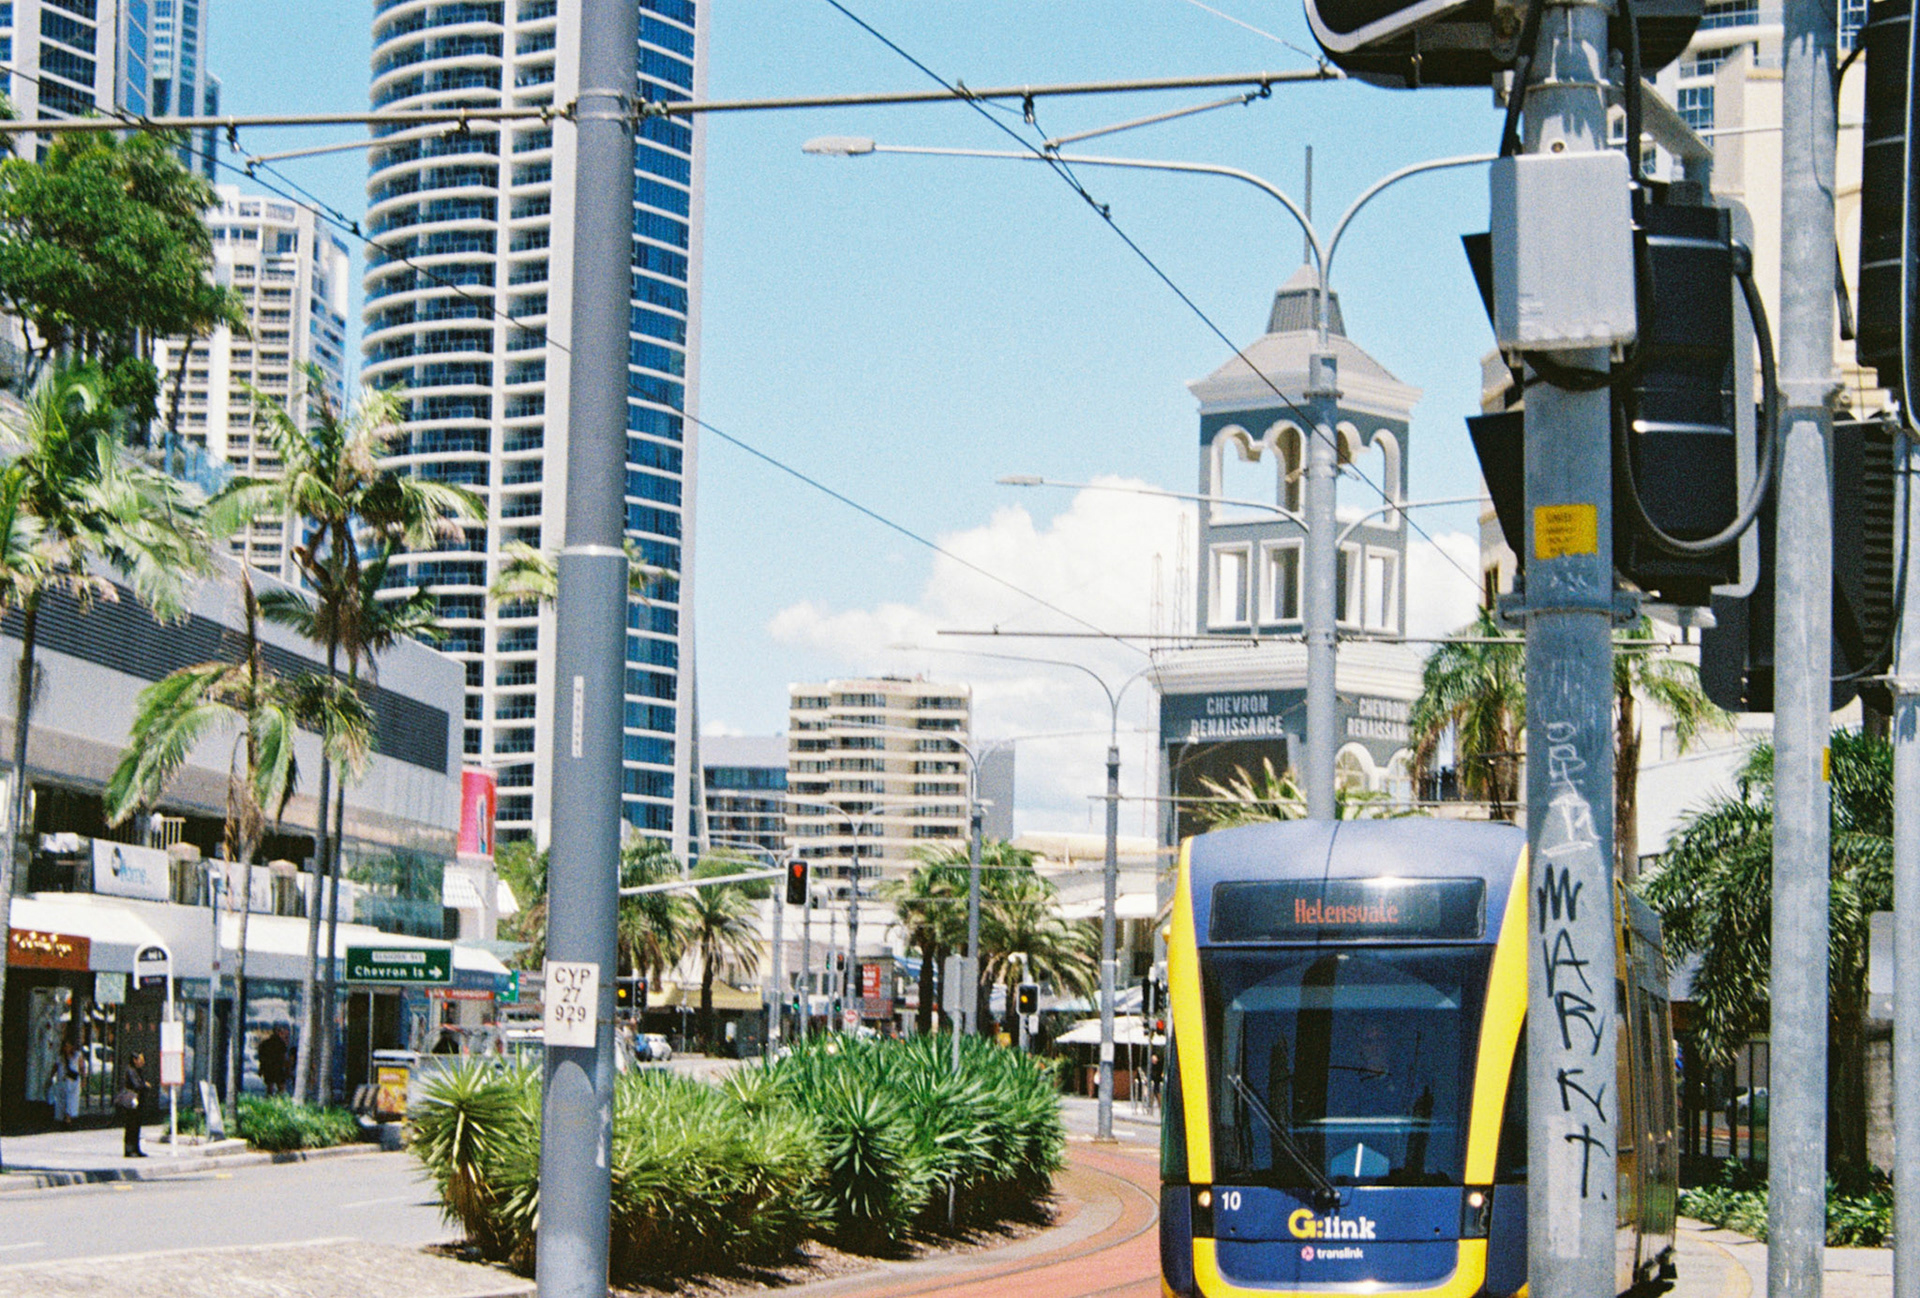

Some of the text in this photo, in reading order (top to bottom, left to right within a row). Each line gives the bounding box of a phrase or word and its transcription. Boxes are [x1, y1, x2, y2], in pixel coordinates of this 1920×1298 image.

[1206, 695, 1269, 716] CHEVRON
[1190, 715, 1284, 738] RENAISSANCE
[1294, 898, 1399, 924] Helensvale
[355, 965, 425, 978] Chevron Is
[554, 967, 591, 987] CYP
[562, 986, 581, 1003] 27
[555, 1004, 586, 1022] 929
[1221, 1191, 1242, 1211] 10
[1288, 1208, 1377, 1239] G:link
[1316, 1246, 1364, 1260] translink
